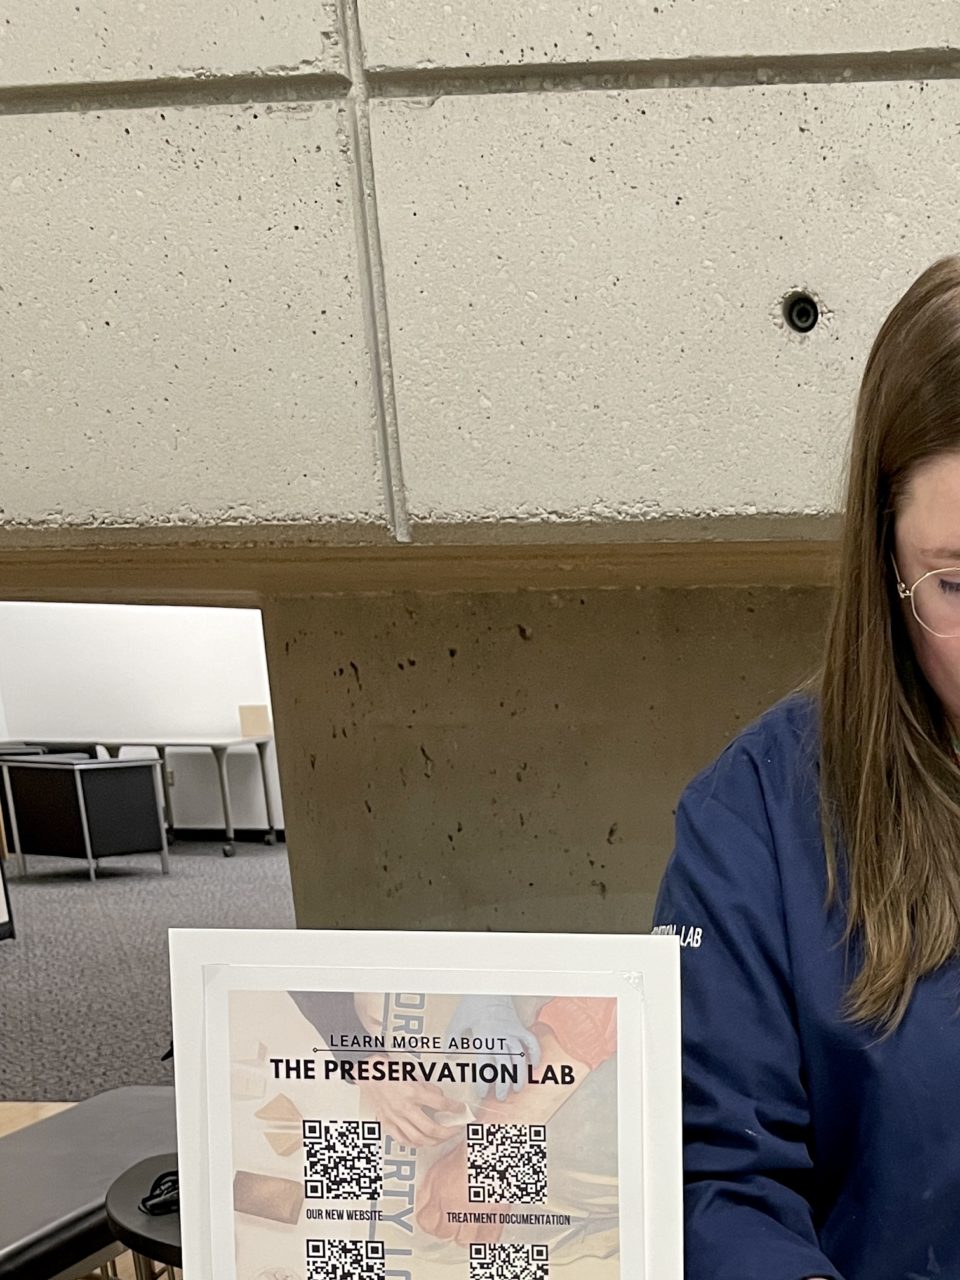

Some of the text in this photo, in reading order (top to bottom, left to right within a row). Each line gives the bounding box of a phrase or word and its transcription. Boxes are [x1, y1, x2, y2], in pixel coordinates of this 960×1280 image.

[680, 925, 703, 948] LAB
[330, 1034, 507, 1050] LEARN MORE ABOUT
[269, 1058, 575, 1085] THE PRESERVATION LAB
[306, 1208, 383, 1221] OUR NEW WEBSITE
[446, 1212, 571, 1225] TREATMENT DOCUMENTATION
